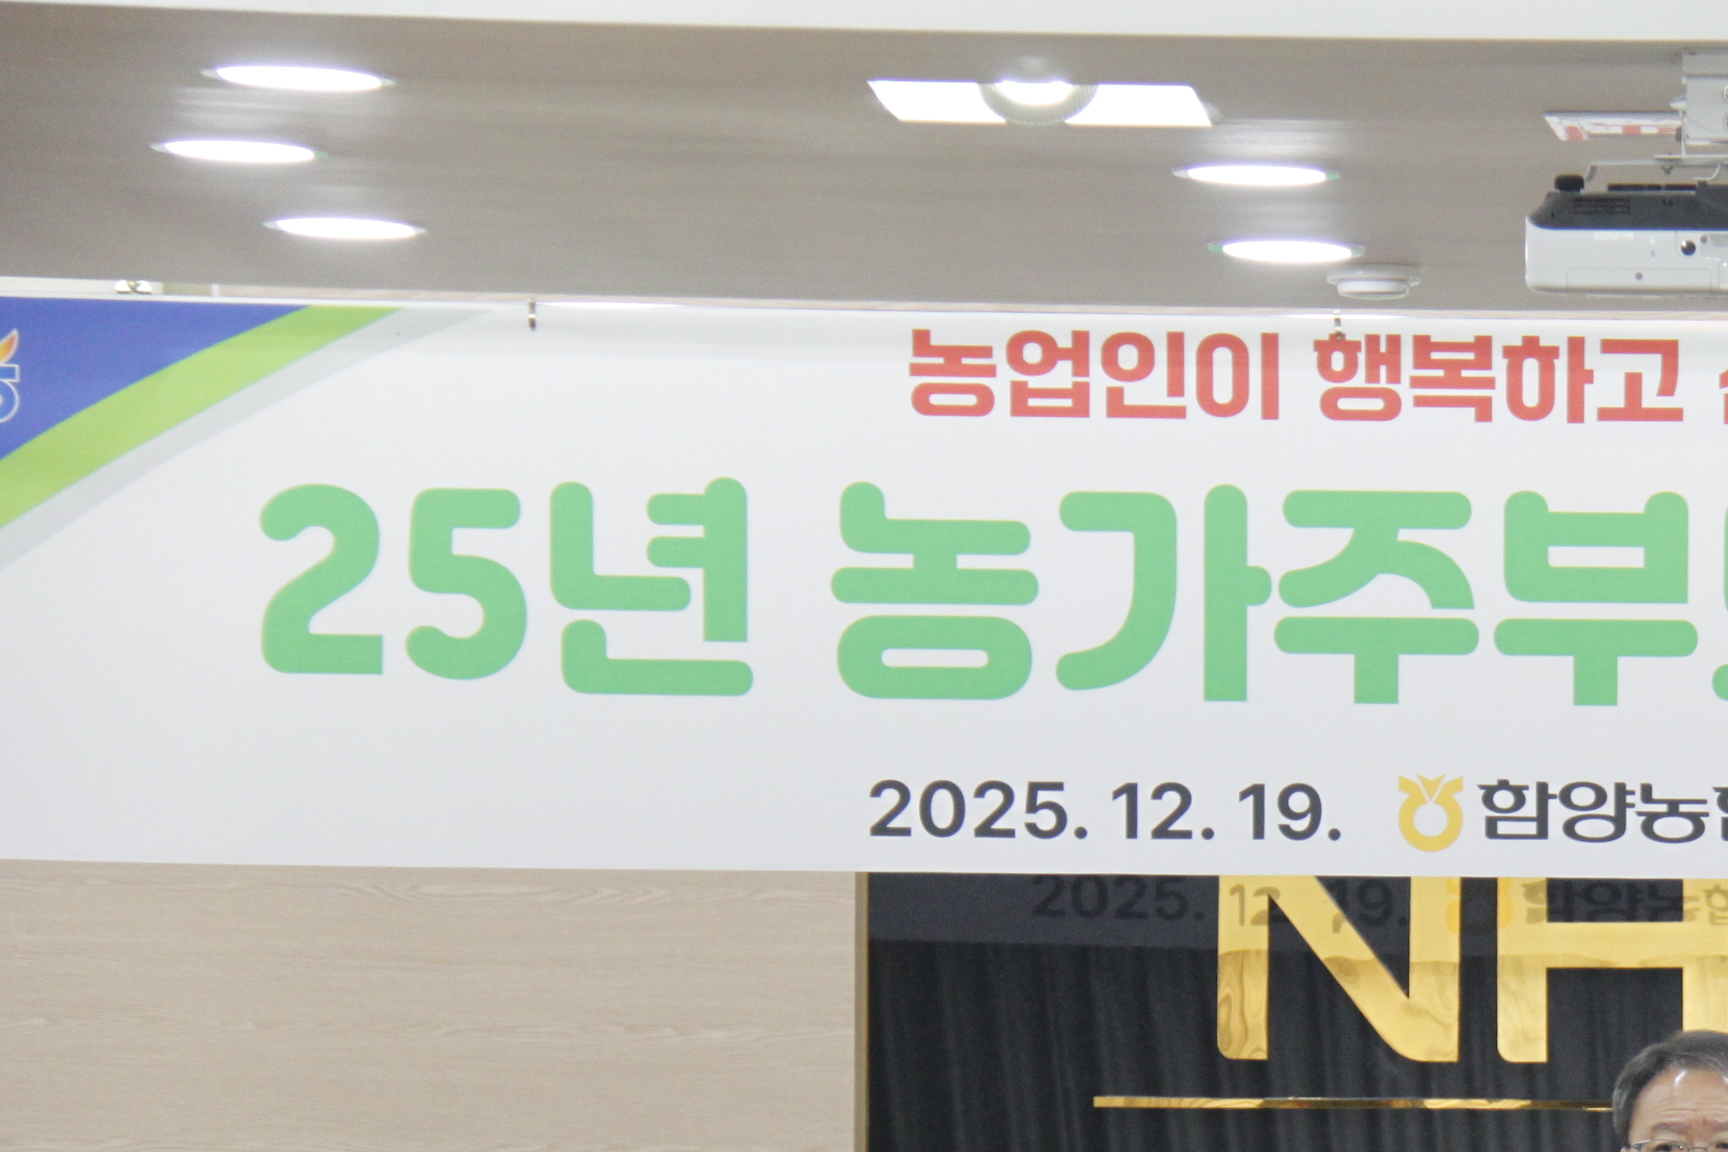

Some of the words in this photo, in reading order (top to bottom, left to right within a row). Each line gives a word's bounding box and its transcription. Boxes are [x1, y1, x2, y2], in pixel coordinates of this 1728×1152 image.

[909, 328, 1280, 420] 농업인이
[1313, 331, 1684, 424] 행복하고
[259, 476, 754, 697] 25년
[869, 779, 1088, 840] 2025.
[1112, 782, 1215, 840] 12.
[1239, 783, 1341, 841] 19.
